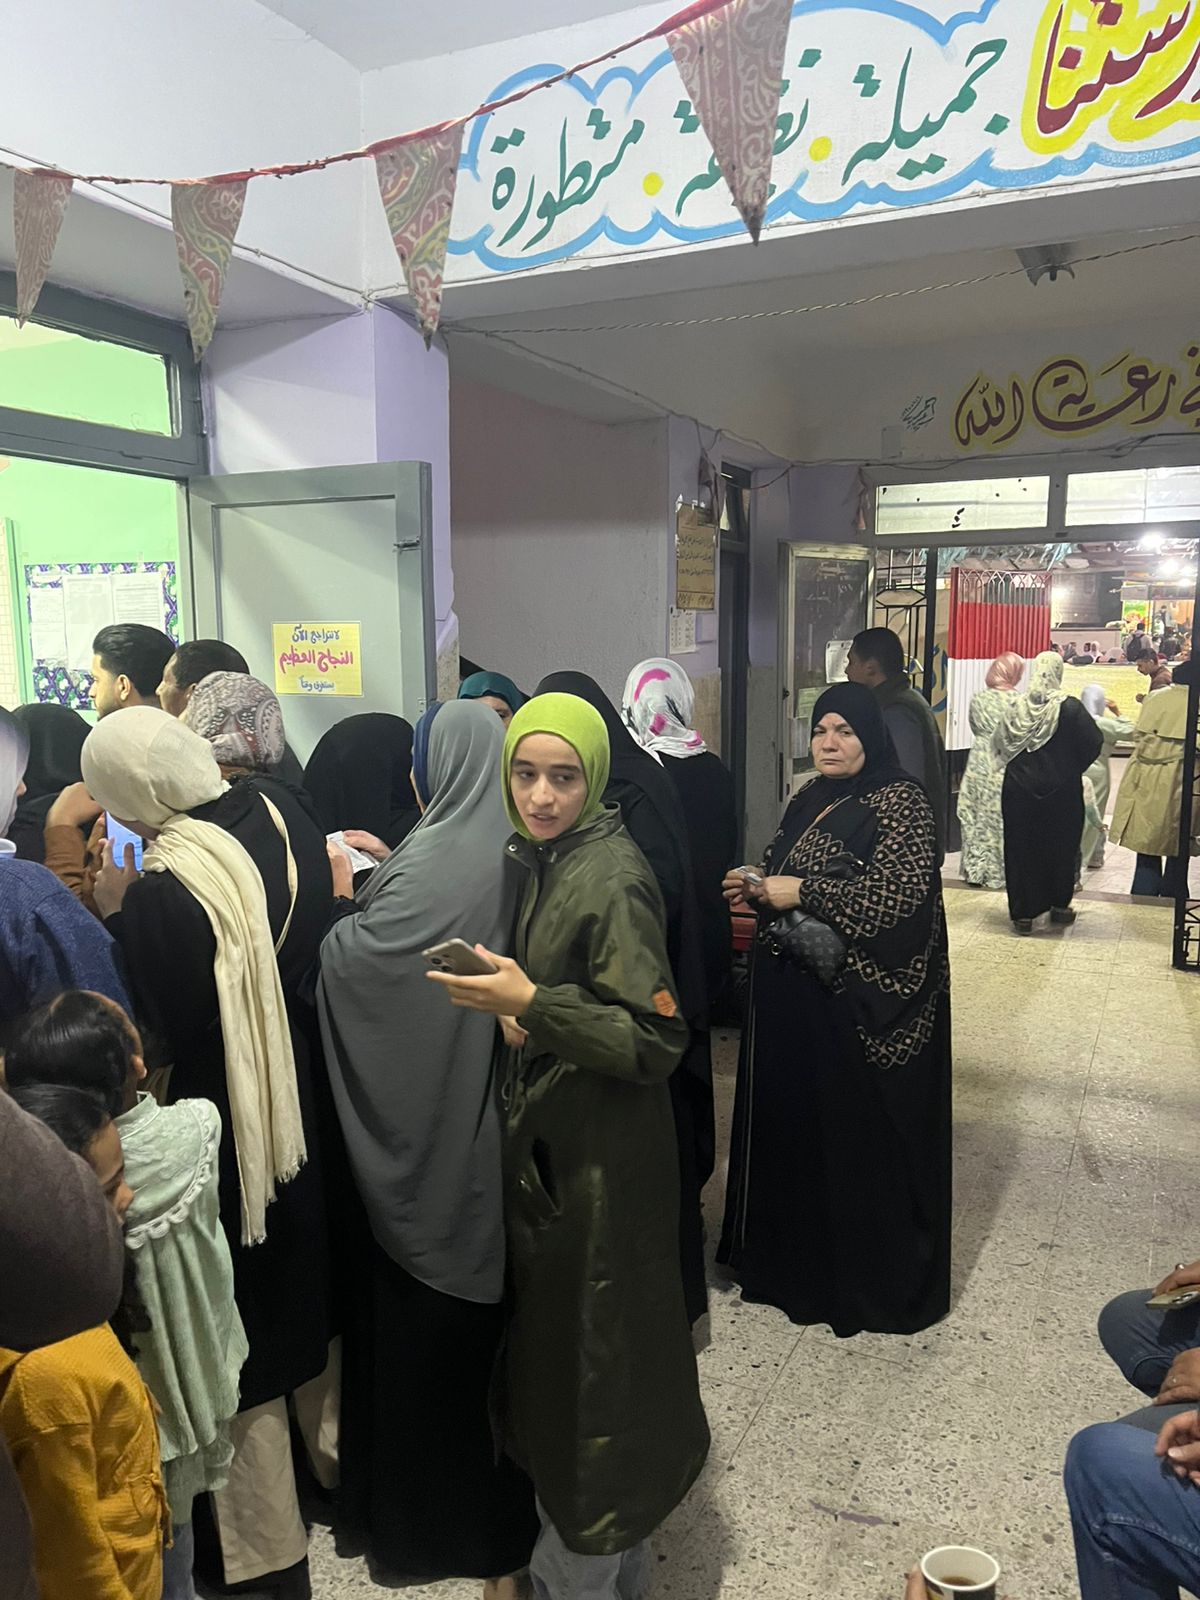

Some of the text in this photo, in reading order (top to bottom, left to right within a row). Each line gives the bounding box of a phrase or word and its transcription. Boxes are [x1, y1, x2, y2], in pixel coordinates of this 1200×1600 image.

[842, 39, 1010, 186] جميلة
[490, 107, 645, 251] متطورة
[955, 377, 1024, 446] الله
[279, 645, 353, 674] النجاح العظيم
